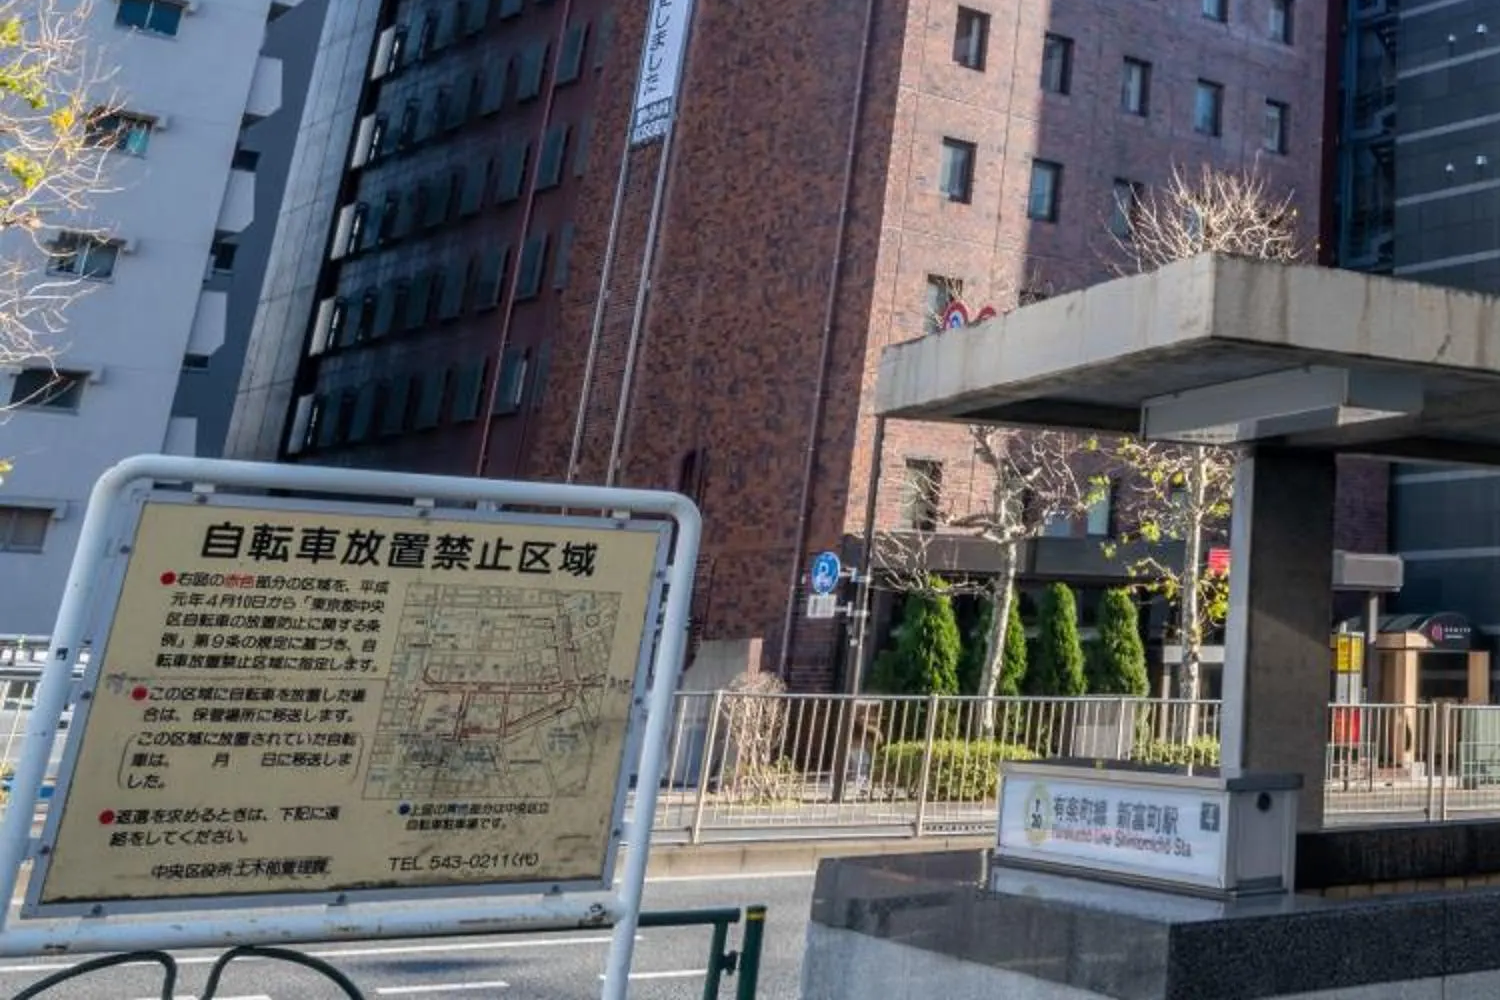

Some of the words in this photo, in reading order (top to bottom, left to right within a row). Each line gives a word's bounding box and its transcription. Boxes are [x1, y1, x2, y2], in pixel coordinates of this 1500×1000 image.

[201, 521, 598, 575] 自転車放置禁止区域
[211, 753, 230, 767] 月
[1116, 800, 1179, 835] 新富町駅
[387, 856, 425, 870] TEL
